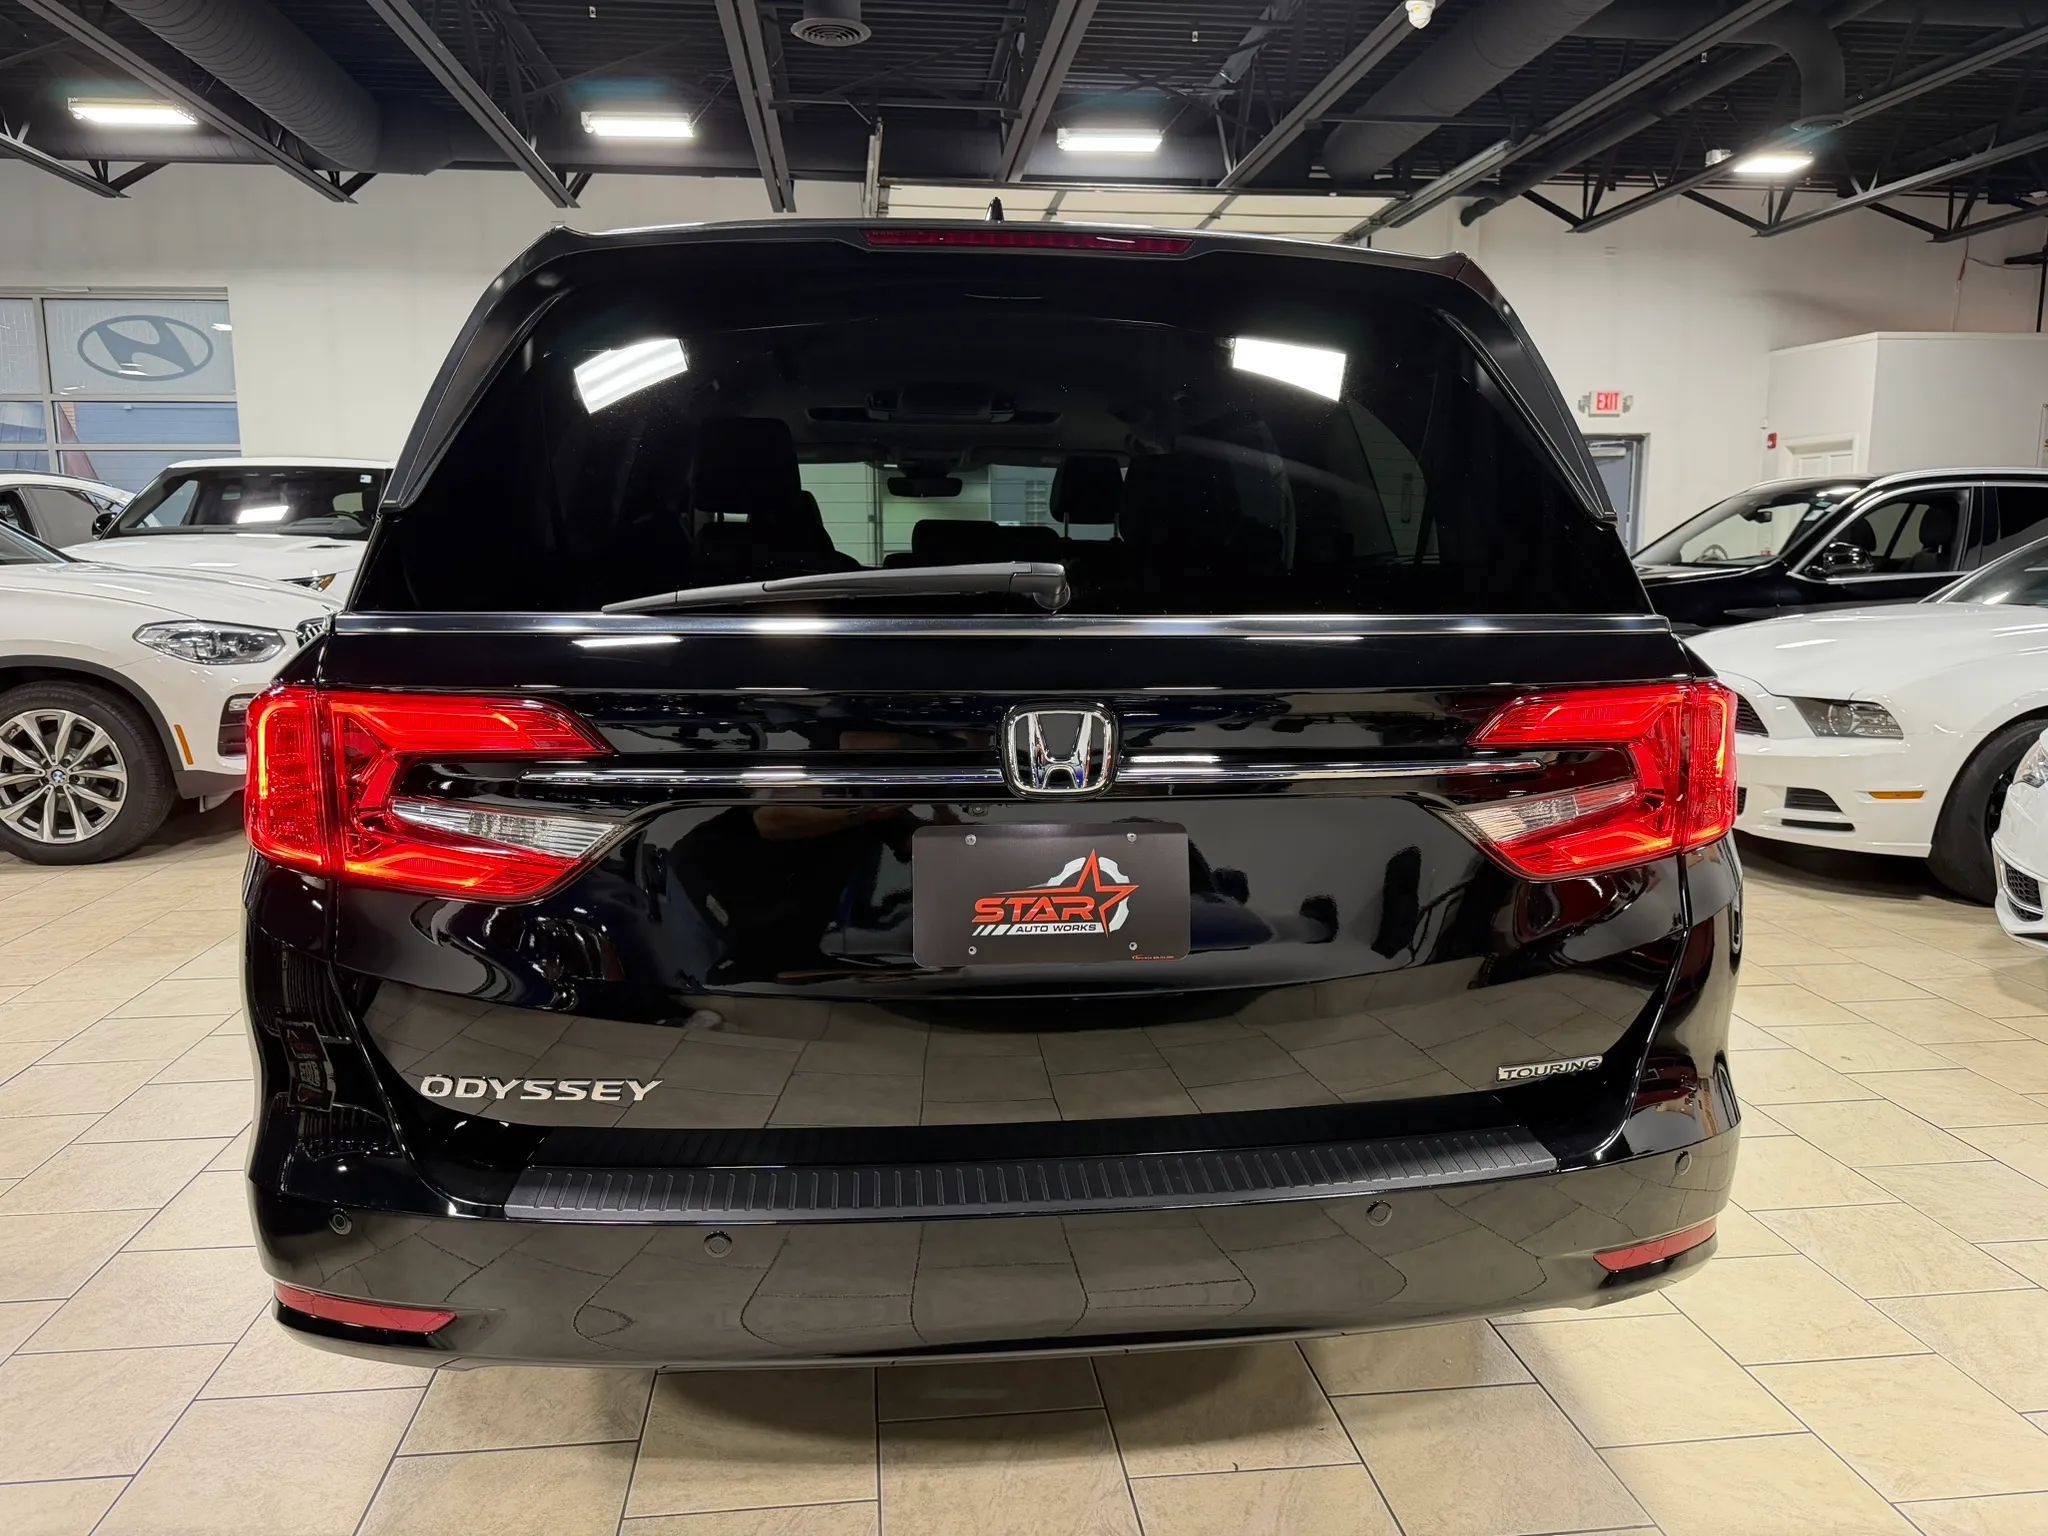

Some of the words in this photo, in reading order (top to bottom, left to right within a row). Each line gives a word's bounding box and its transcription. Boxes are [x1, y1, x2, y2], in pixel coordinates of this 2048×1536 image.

[1597, 392, 1619, 410] EXIT
[973, 896, 1095, 923] STAR
[1015, 925, 1049, 933] AUTO
[1052, 924, 1097, 932] WORKS
[1504, 1059, 1600, 1079] TOURING
[420, 1075, 663, 1101] ODYSSEY
